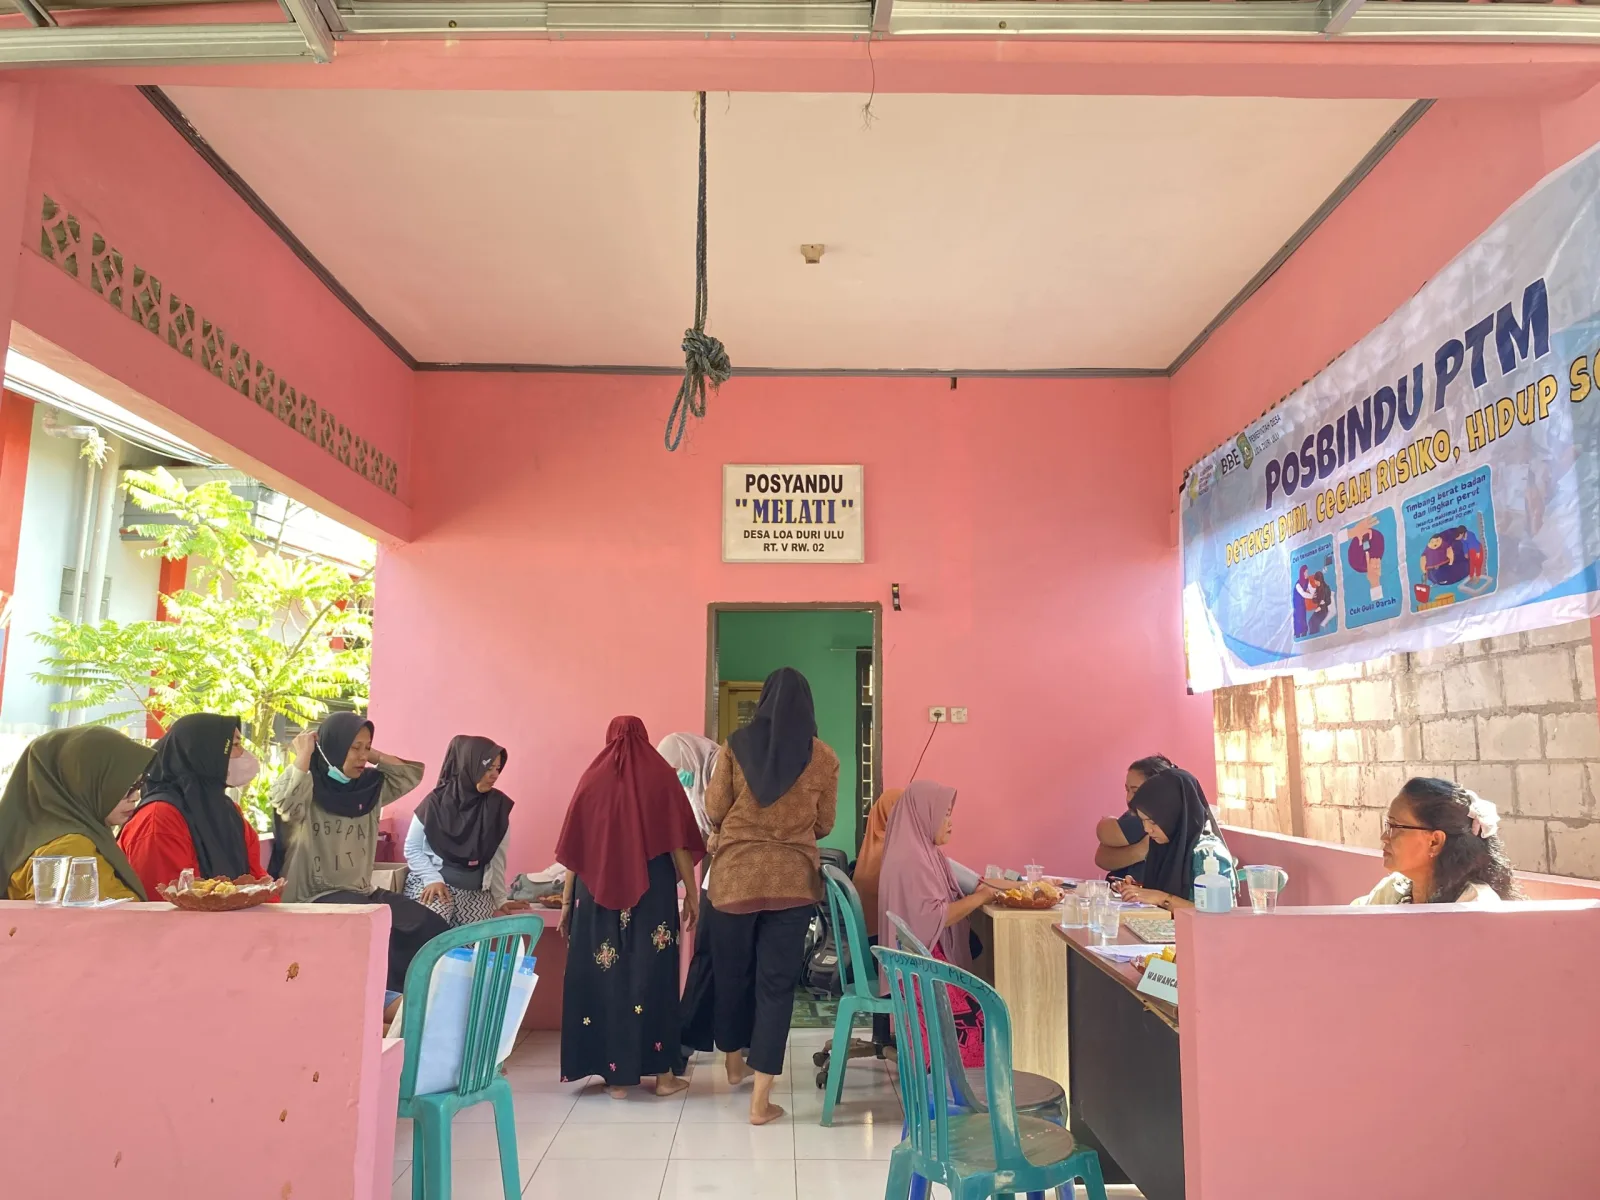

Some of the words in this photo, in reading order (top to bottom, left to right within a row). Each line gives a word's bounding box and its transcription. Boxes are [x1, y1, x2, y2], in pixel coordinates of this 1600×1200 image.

[1265, 363, 1424, 510] POSBINDU
[1434, 277, 1550, 412] PTM
[1377, 429, 1460, 495] RISIKO,
[1466, 374, 1558, 453] HIDUP
[1220, 448, 1241, 475] BBE
[745, 474, 843, 493] POSYANDU
[1406, 496, 1436, 513] Timbang
[1437, 485, 1459, 500] berat
[1461, 474, 1486, 490] badan
[1413, 510, 1426, 520] dan
[1427, 498, 1454, 515] lingkar
[1457, 487, 1480, 504] perut
[743, 530, 770, 539] DESA
[773, 530, 794, 539] LOA
[796, 530, 821, 539] DURI
[824, 530, 844, 539] ULU
[763, 543, 778, 552] RT.
[781, 543, 788, 552] V
[791, 543, 809, 552] RW.
[813, 543, 825, 552] 02
[1349, 606, 1361, 616] Cek
[1376, 597, 1396, 608] Darah
